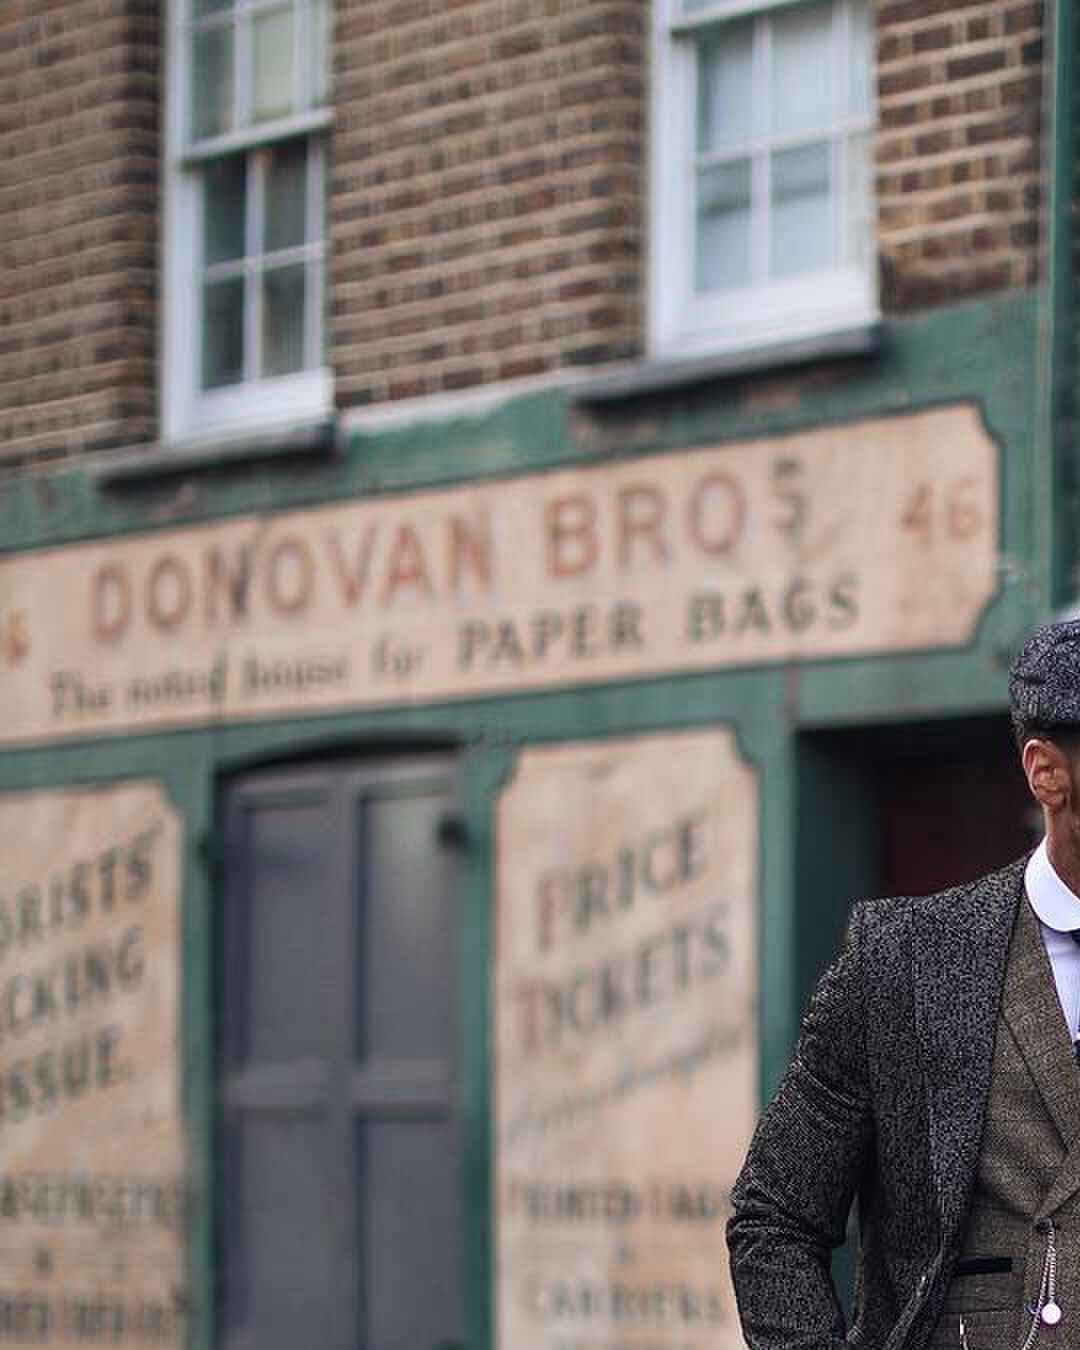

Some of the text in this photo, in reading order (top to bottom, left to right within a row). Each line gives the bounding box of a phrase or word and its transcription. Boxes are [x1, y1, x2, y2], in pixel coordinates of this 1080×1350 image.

[88, 507, 495, 644] DONOVAN
[897, 477, 982, 545] 46
[457, 598, 645, 669] PAPER
[684, 570, 861, 643] BAGS
[0, 922, 146, 1042] CKING
